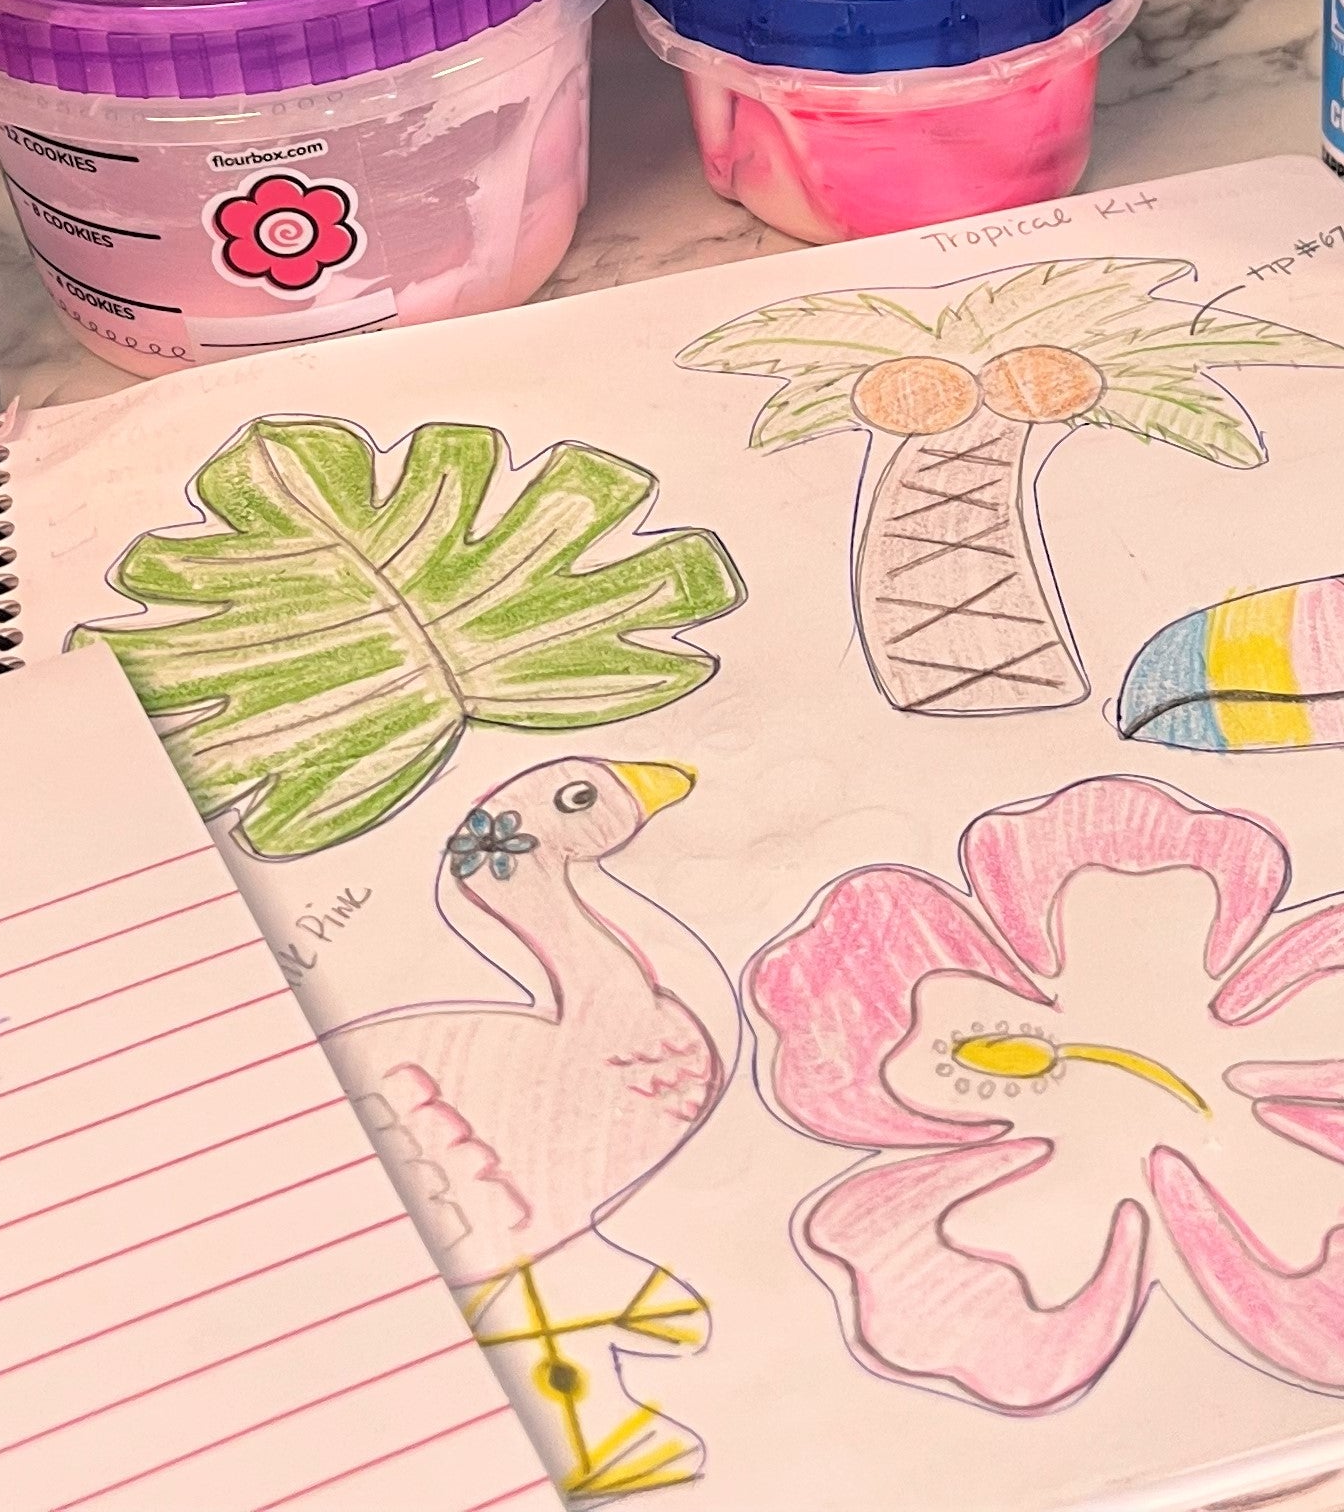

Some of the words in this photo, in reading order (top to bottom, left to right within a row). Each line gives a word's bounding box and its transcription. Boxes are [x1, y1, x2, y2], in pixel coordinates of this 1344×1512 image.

[24, 137, 97, 173] COOKIES
[211, 140, 324, 170] flourbox.com
[43, 209, 114, 249] COOKIES
[920, 208, 1073, 254] Tropical
[65, 281, 136, 321] COOKIES
[296, 886, 373, 943] Pink
